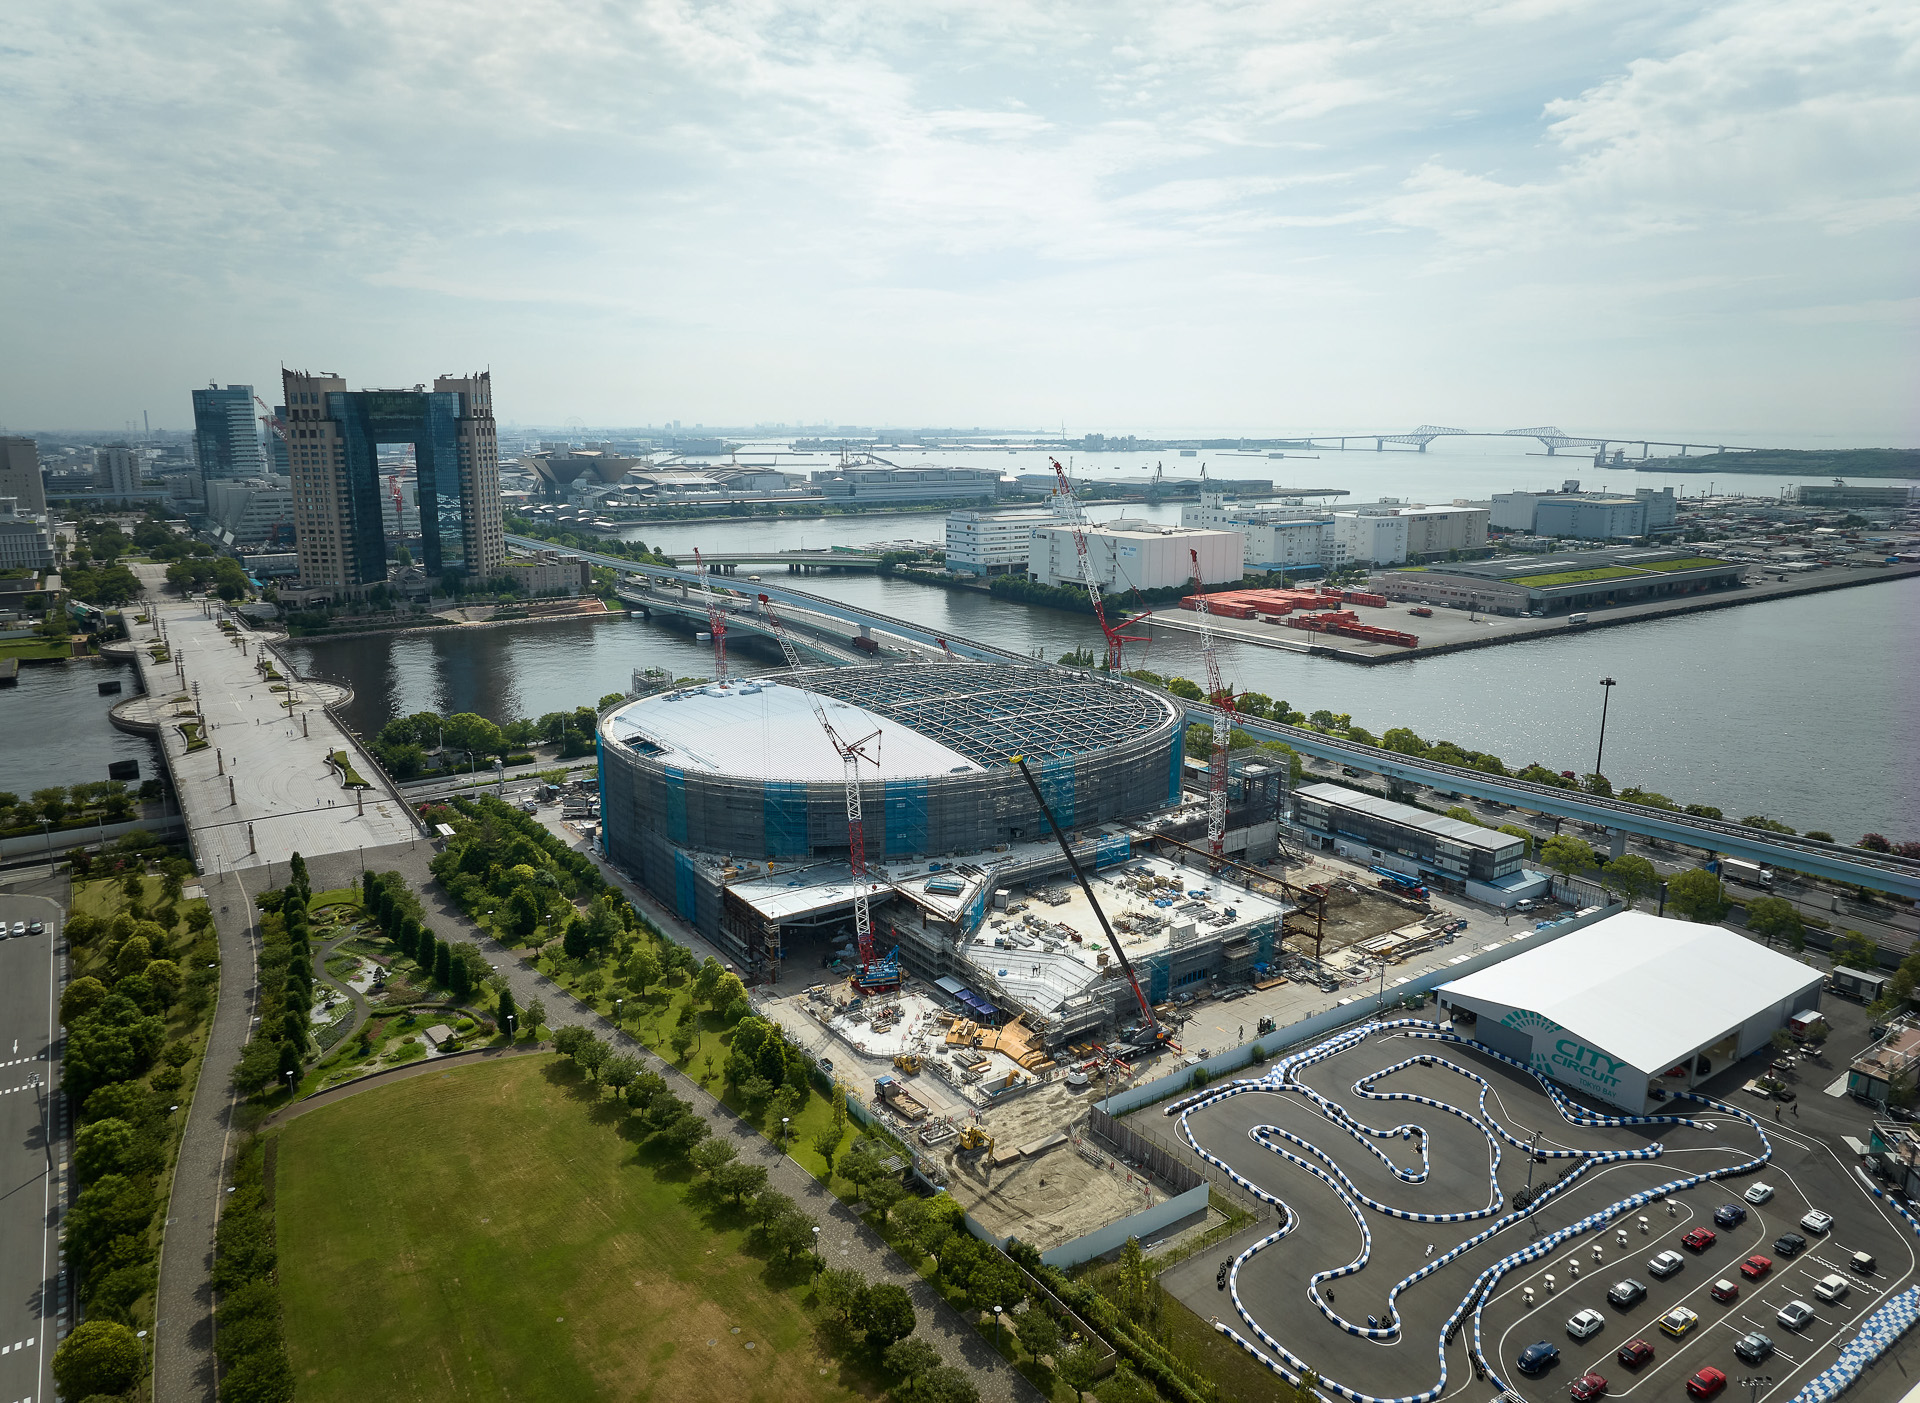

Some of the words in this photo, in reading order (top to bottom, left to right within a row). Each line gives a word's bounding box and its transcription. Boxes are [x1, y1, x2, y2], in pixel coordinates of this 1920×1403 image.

[1551, 1054, 1622, 1087] CIRCUIT
[1556, 1039, 1627, 1075] CITY
[1579, 1078, 1601, 1092] TOKYO
[1602, 1088, 1617, 1098] BAY
